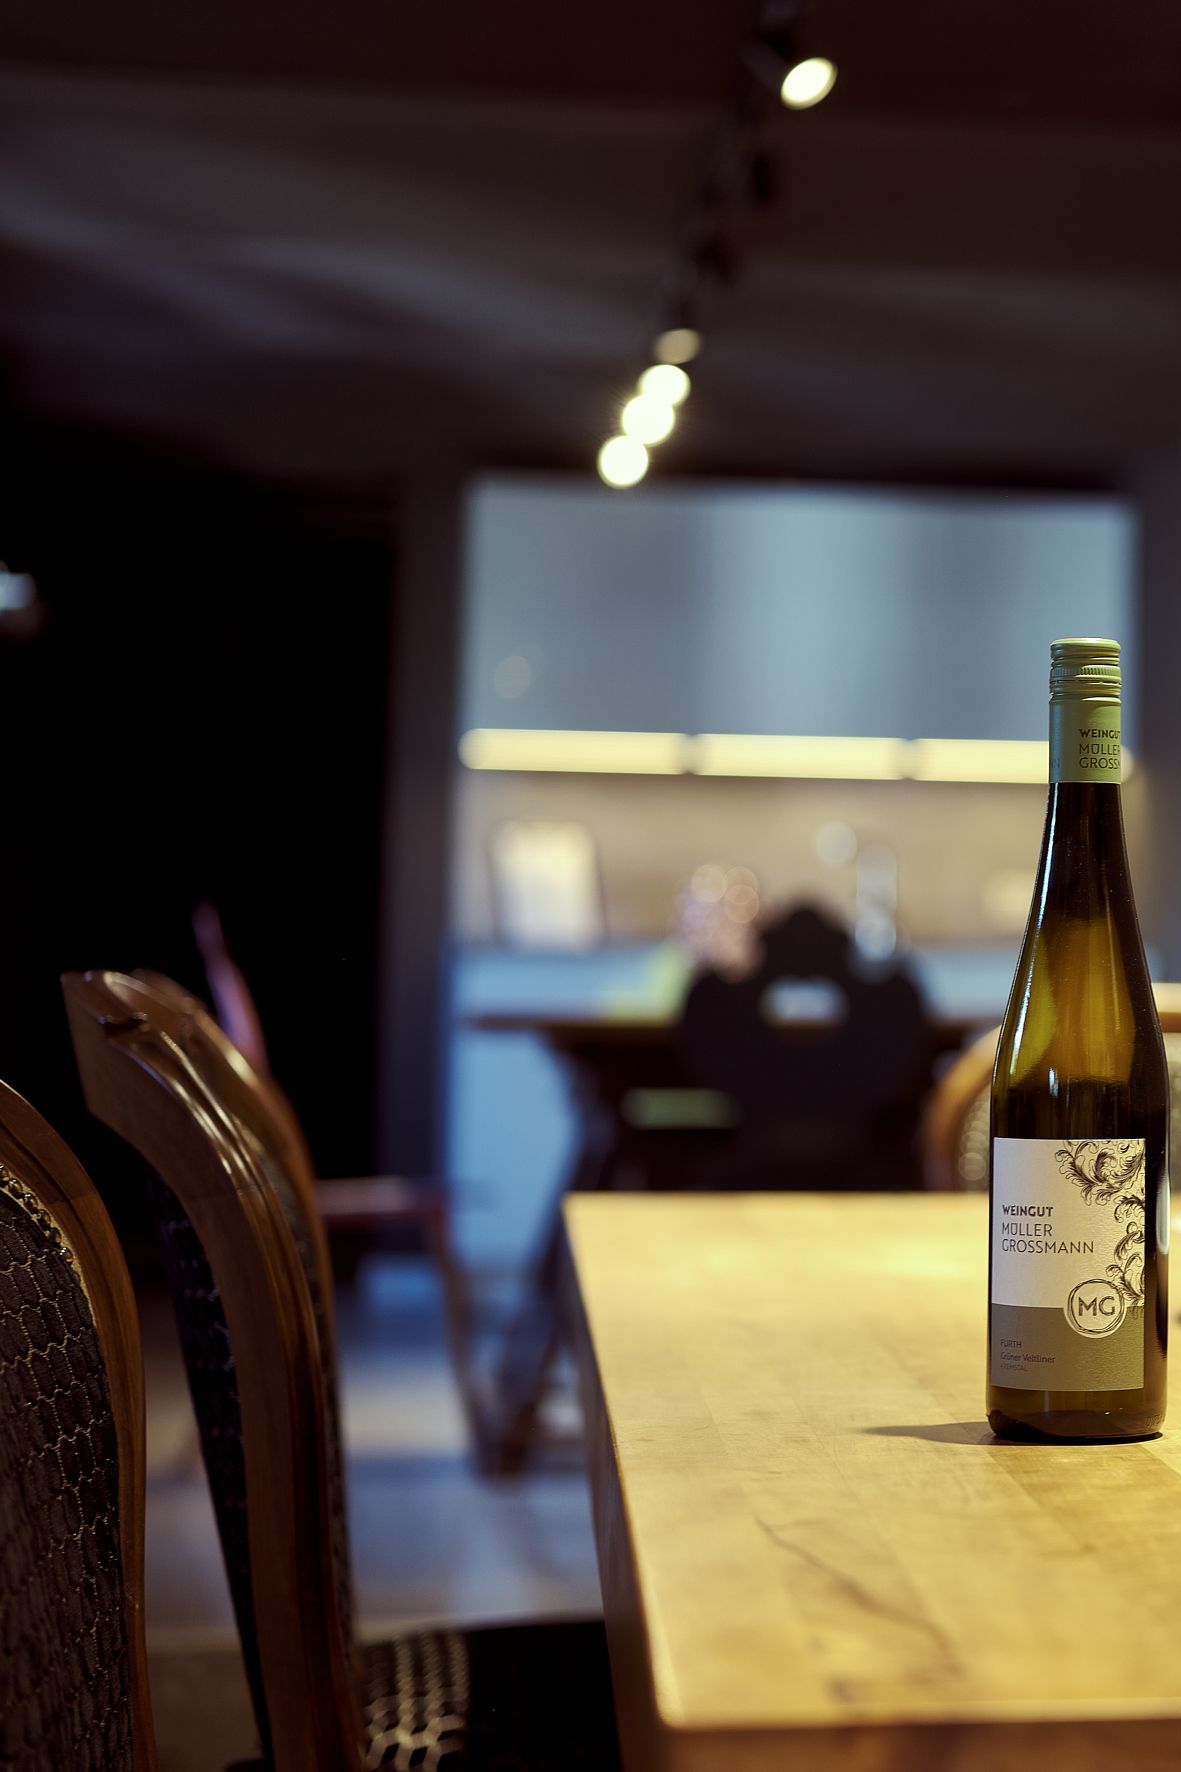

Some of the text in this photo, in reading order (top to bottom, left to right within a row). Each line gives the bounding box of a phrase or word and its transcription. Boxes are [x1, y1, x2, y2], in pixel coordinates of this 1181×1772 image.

[1079, 757, 1120, 770] GROSS
[1002, 1204, 1054, 1217] WEINGUT
[1002, 1221, 1053, 1237] MÜLLER
[1002, 1238, 1095, 1254] GROSSMANN
[1078, 1295, 1116, 1316] MG
